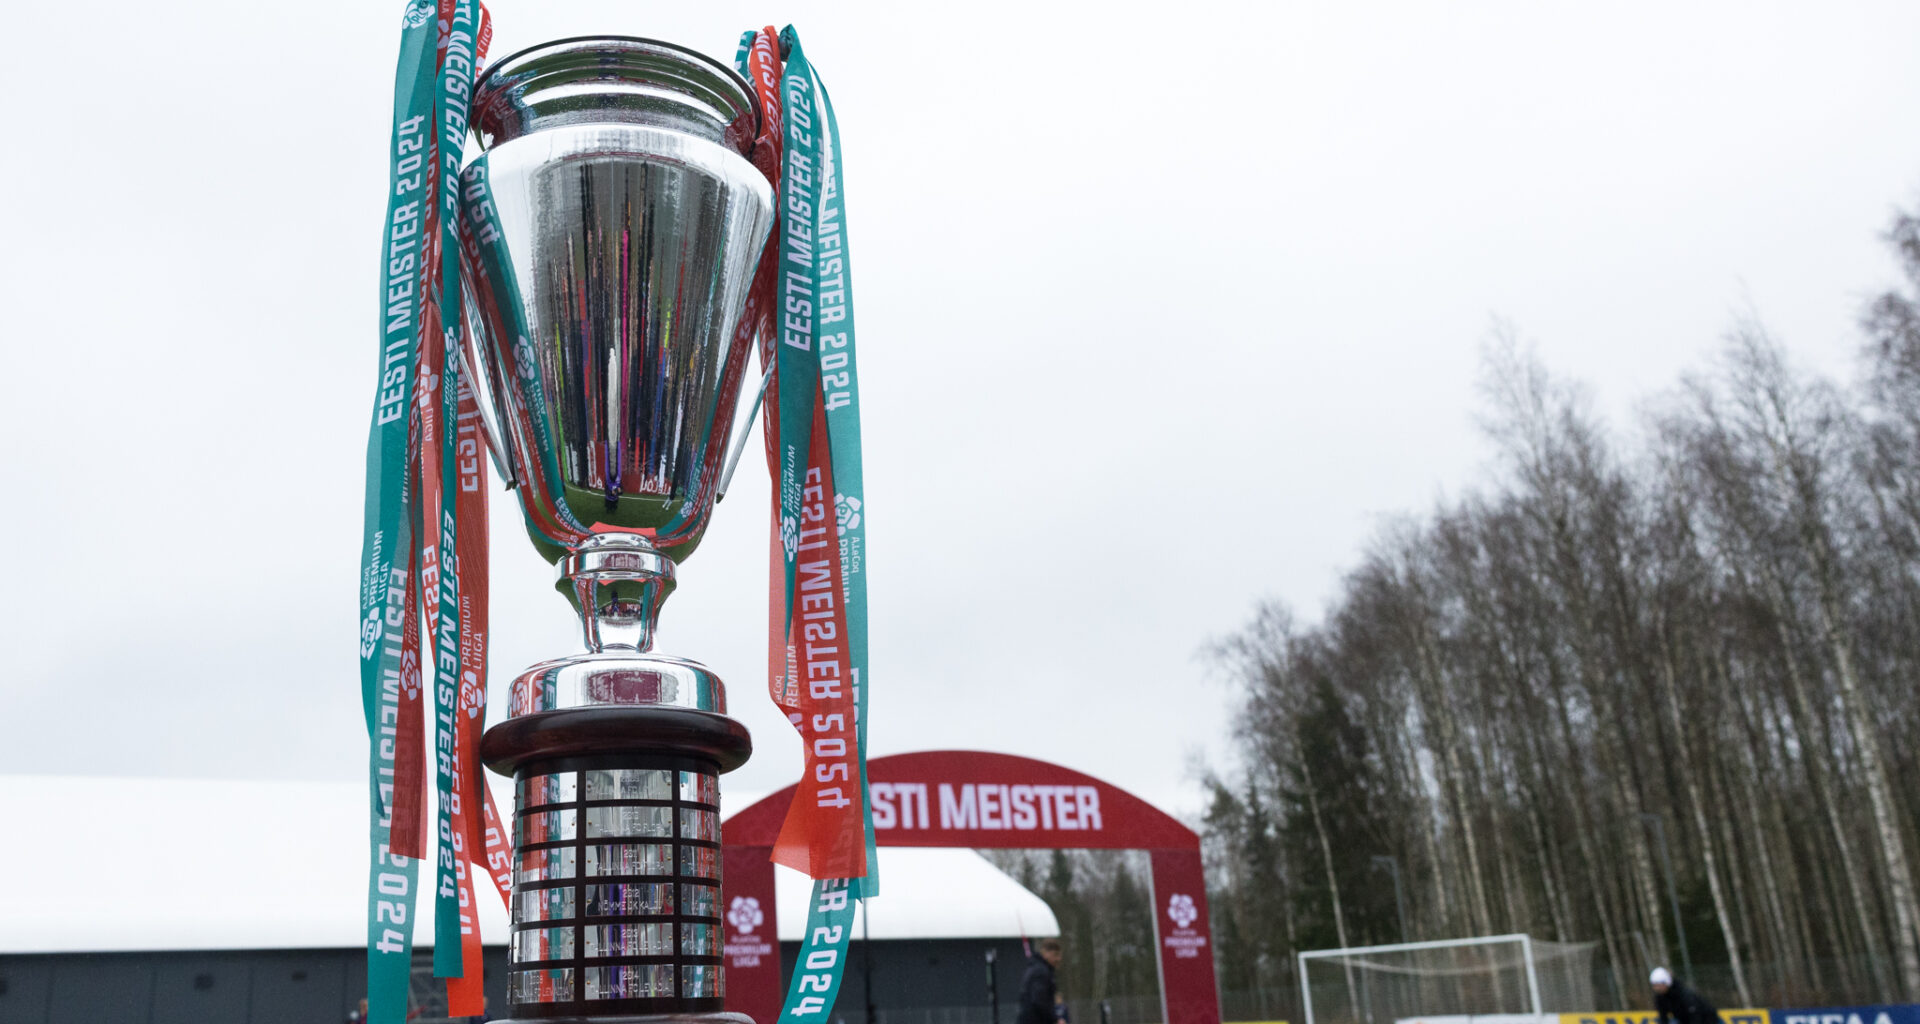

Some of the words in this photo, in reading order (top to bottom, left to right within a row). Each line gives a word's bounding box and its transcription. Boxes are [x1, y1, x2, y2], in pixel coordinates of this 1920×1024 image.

[445, 30, 472, 152] MEISTER
[788, 75, 811, 149] 2024
[397, 114, 425, 196] 2024
[787, 149, 812, 268] MEISTER
[387, 200, 420, 333] MEISTER
[818, 206, 846, 325] MEISTER
[784, 271, 813, 352] EESTI
[378, 338, 409, 426] EESTI
[820, 332, 851, 411] 2024
[788, 444, 796, 512] PREMIUM
[793, 483, 802, 518] LIIGA
[368, 530, 384, 606] PREMIUM
[377, 561, 390, 602] LIIGA
[440, 509, 456, 612] EESTI
[385, 567, 408, 657] EESTI
[461, 595, 472, 666] PREMIUM
[473, 632, 483, 670] LIIGA
[438, 614, 457, 777] MEISTER
[786, 645, 798, 708] REMIUM
[439, 790, 456, 899] 2024
[869, 783, 929, 830] STI
[938, 783, 1103, 831] MEISTER
[376, 843, 409, 954] 2024
[622, 889, 640, 898] 2012
[790, 925, 843, 1017] 2024
